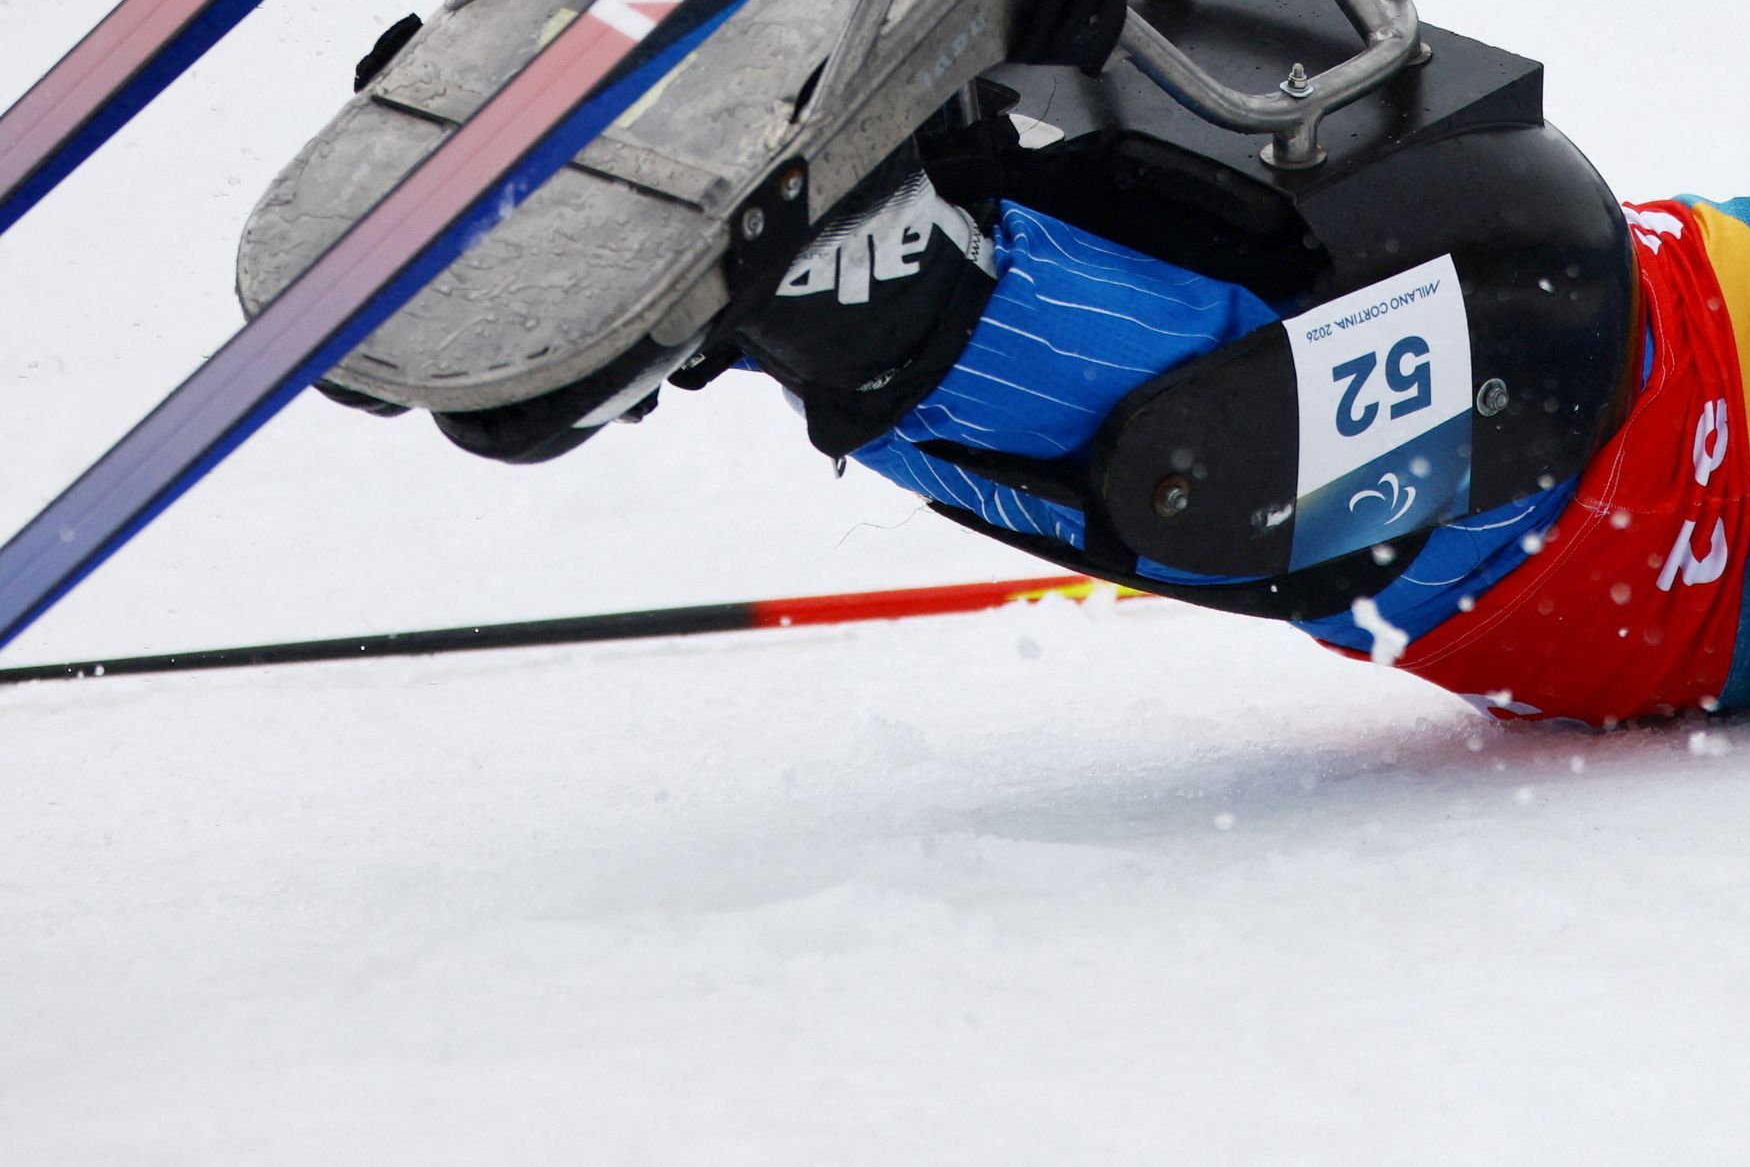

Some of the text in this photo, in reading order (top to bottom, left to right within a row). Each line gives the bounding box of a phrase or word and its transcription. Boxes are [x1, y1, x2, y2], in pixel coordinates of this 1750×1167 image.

[1306, 279, 1441, 345] MILANO CORTINA 2026
[1332, 335, 1432, 437] 52
